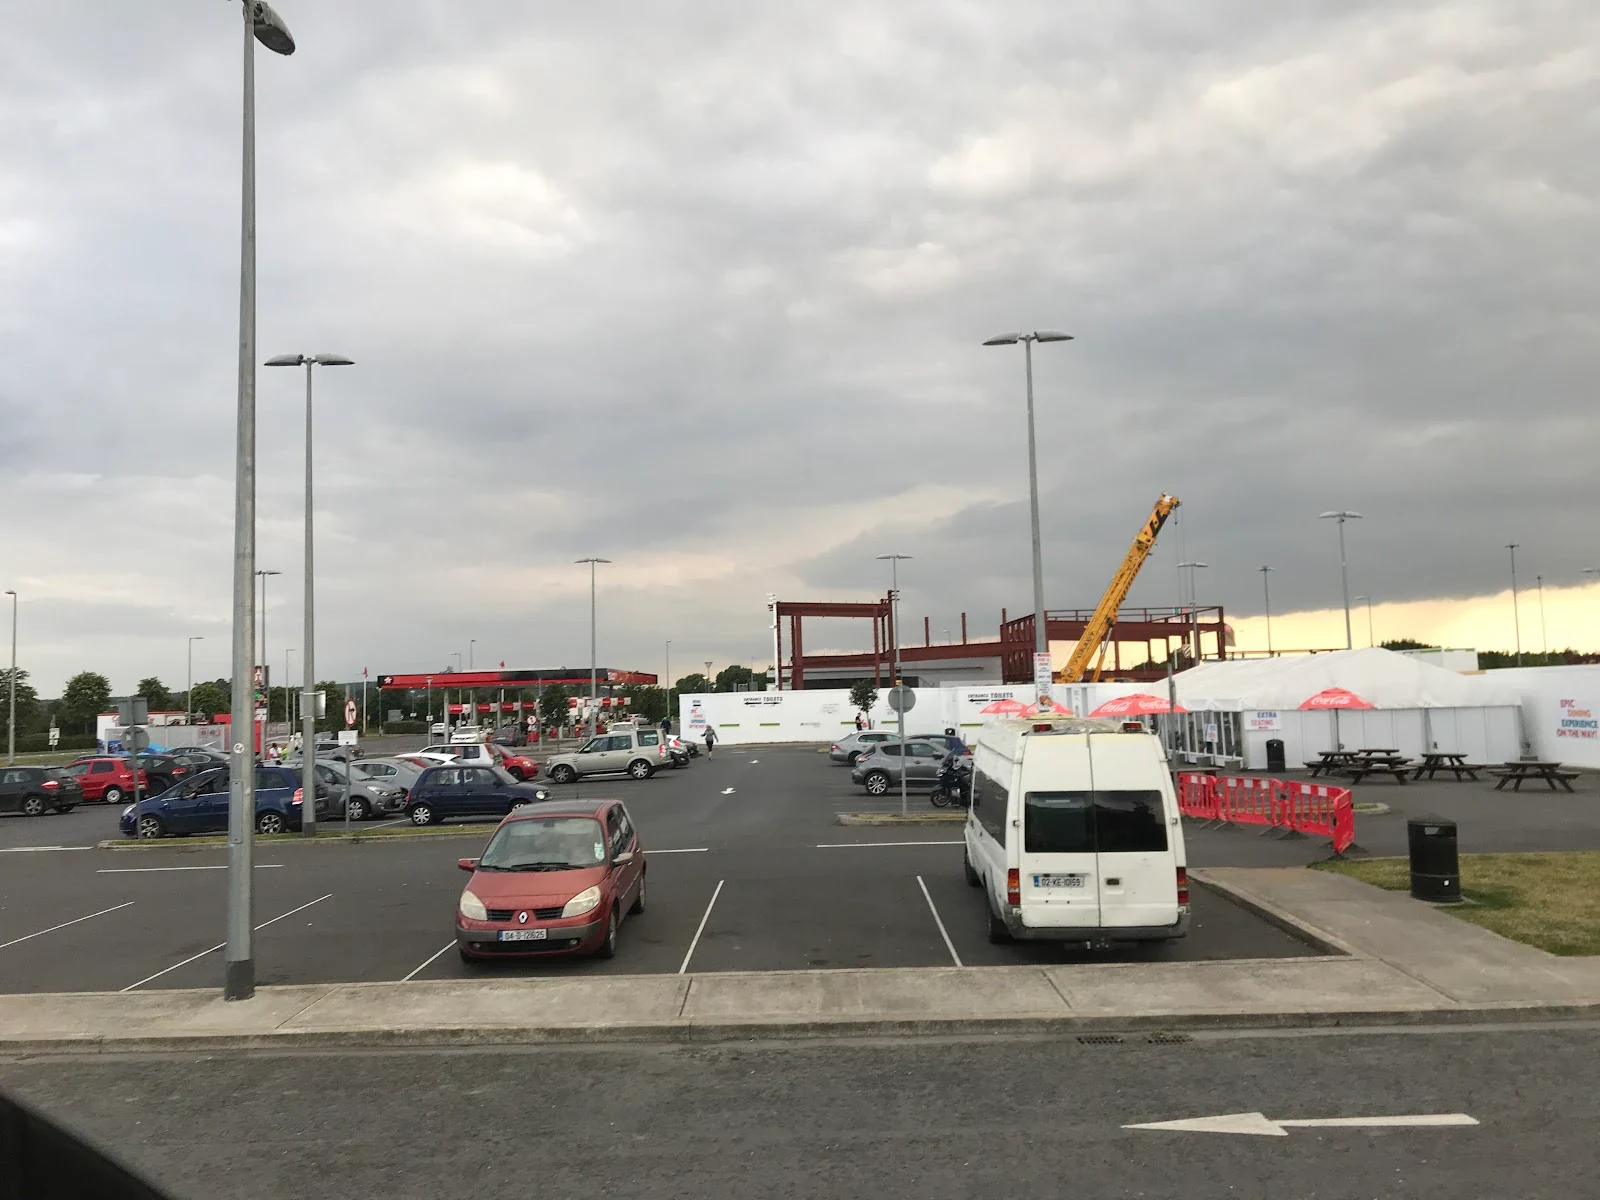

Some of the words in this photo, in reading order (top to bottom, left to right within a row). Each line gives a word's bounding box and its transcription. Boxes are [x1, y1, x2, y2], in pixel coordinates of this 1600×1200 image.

[1312, 695, 1351, 705] Coca-Cola
[1560, 699, 1575, 708] EPIC
[1100, 701, 1133, 712] Coca-Cola
[1561, 719, 1599, 728] EXPERIENCE
